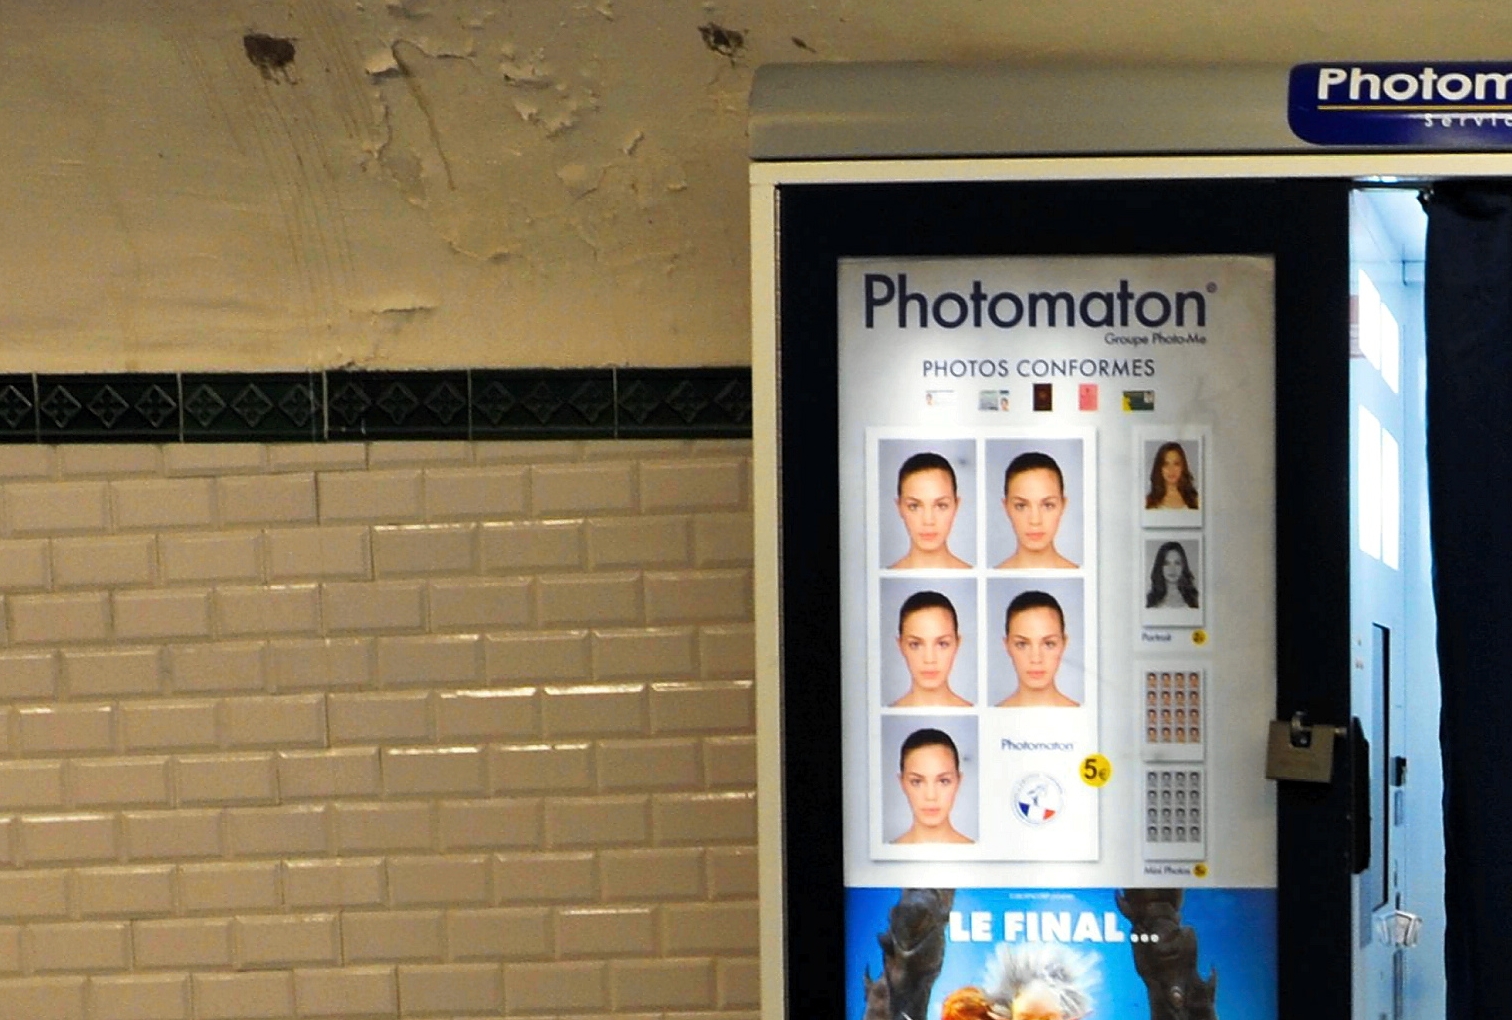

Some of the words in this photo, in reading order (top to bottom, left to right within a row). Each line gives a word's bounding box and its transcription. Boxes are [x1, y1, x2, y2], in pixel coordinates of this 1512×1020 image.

[864, 273, 1207, 329] Photomaton
[1104, 332, 1149, 347] Groupe
[923, 360, 1009, 377] PHOTOS
[1016, 359, 1156, 377] CONFORMES
[1001, 738, 1074, 751] Photomaton
[949, 911, 992, 943] LE
